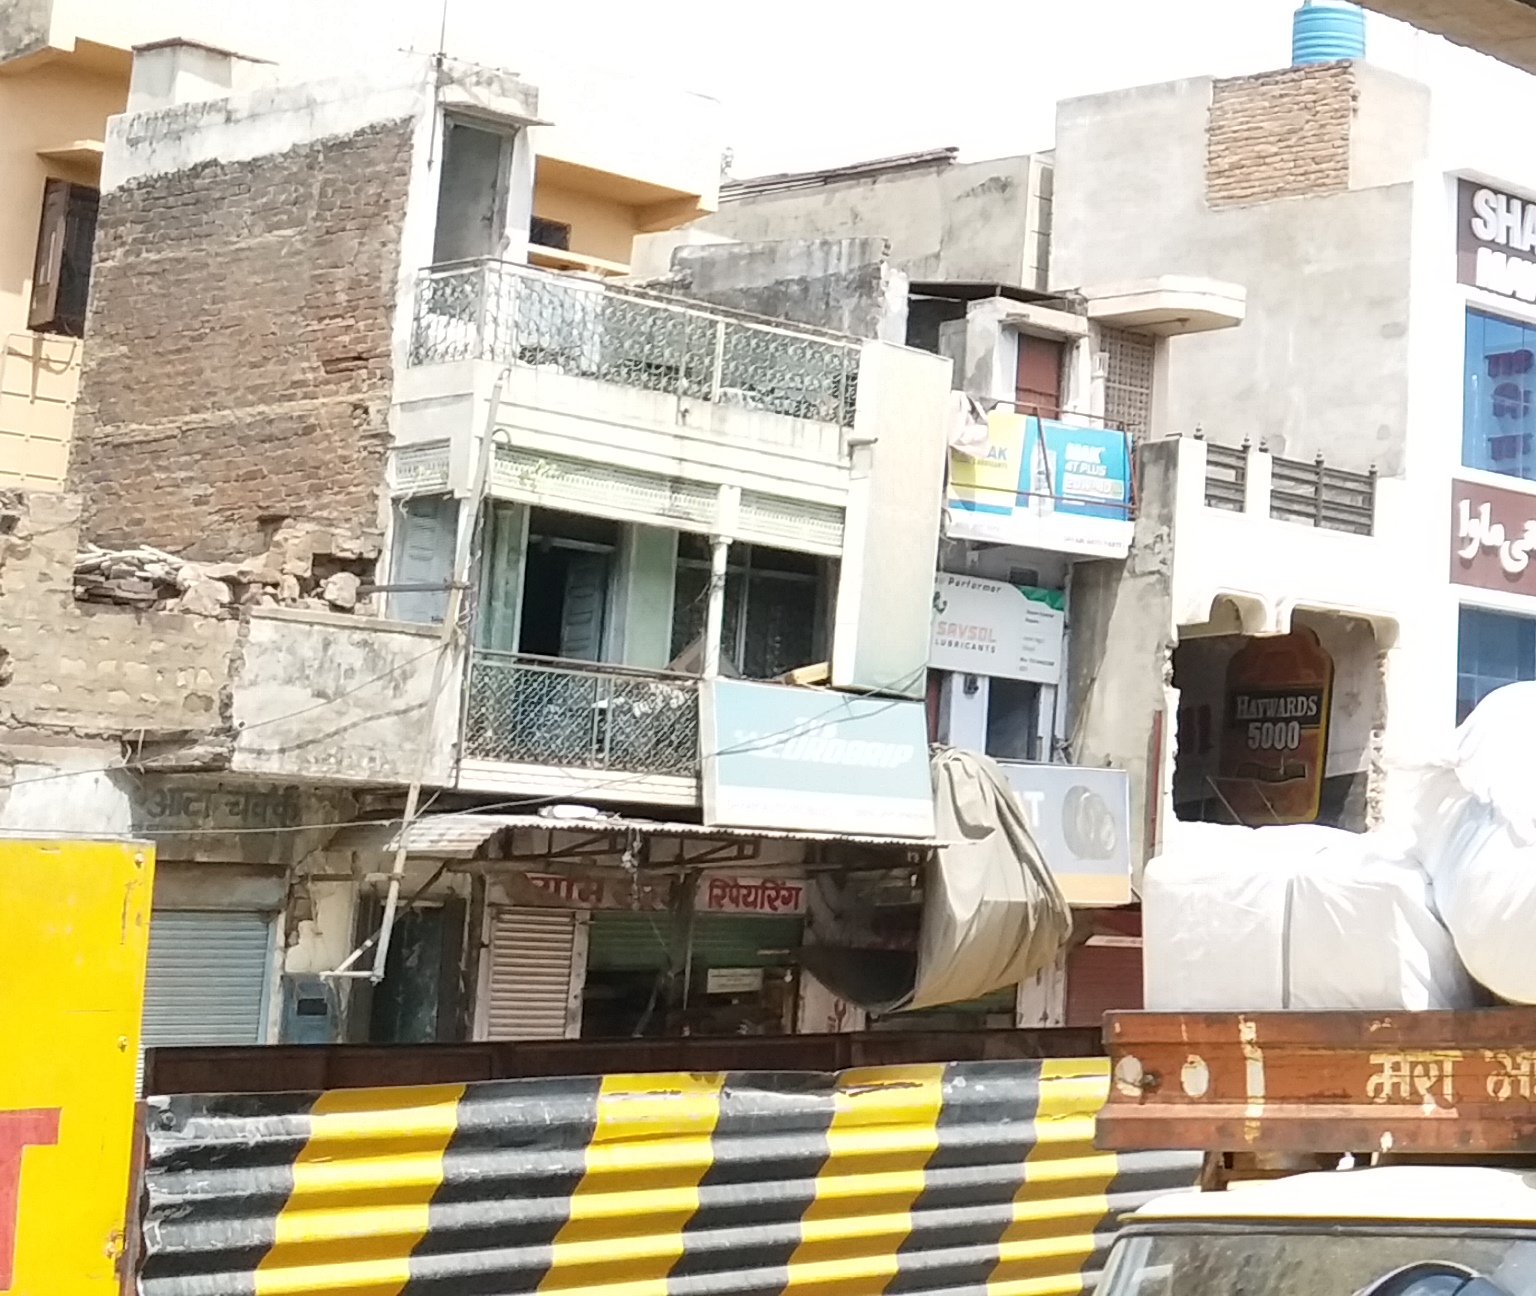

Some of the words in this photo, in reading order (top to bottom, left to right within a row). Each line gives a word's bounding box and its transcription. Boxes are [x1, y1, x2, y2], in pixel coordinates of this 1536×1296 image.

[935, 638, 996, 653] LUBRICANTS
[1236, 695, 1318, 719] HAYWARDS
[1248, 720, 1300, 750] 5000
